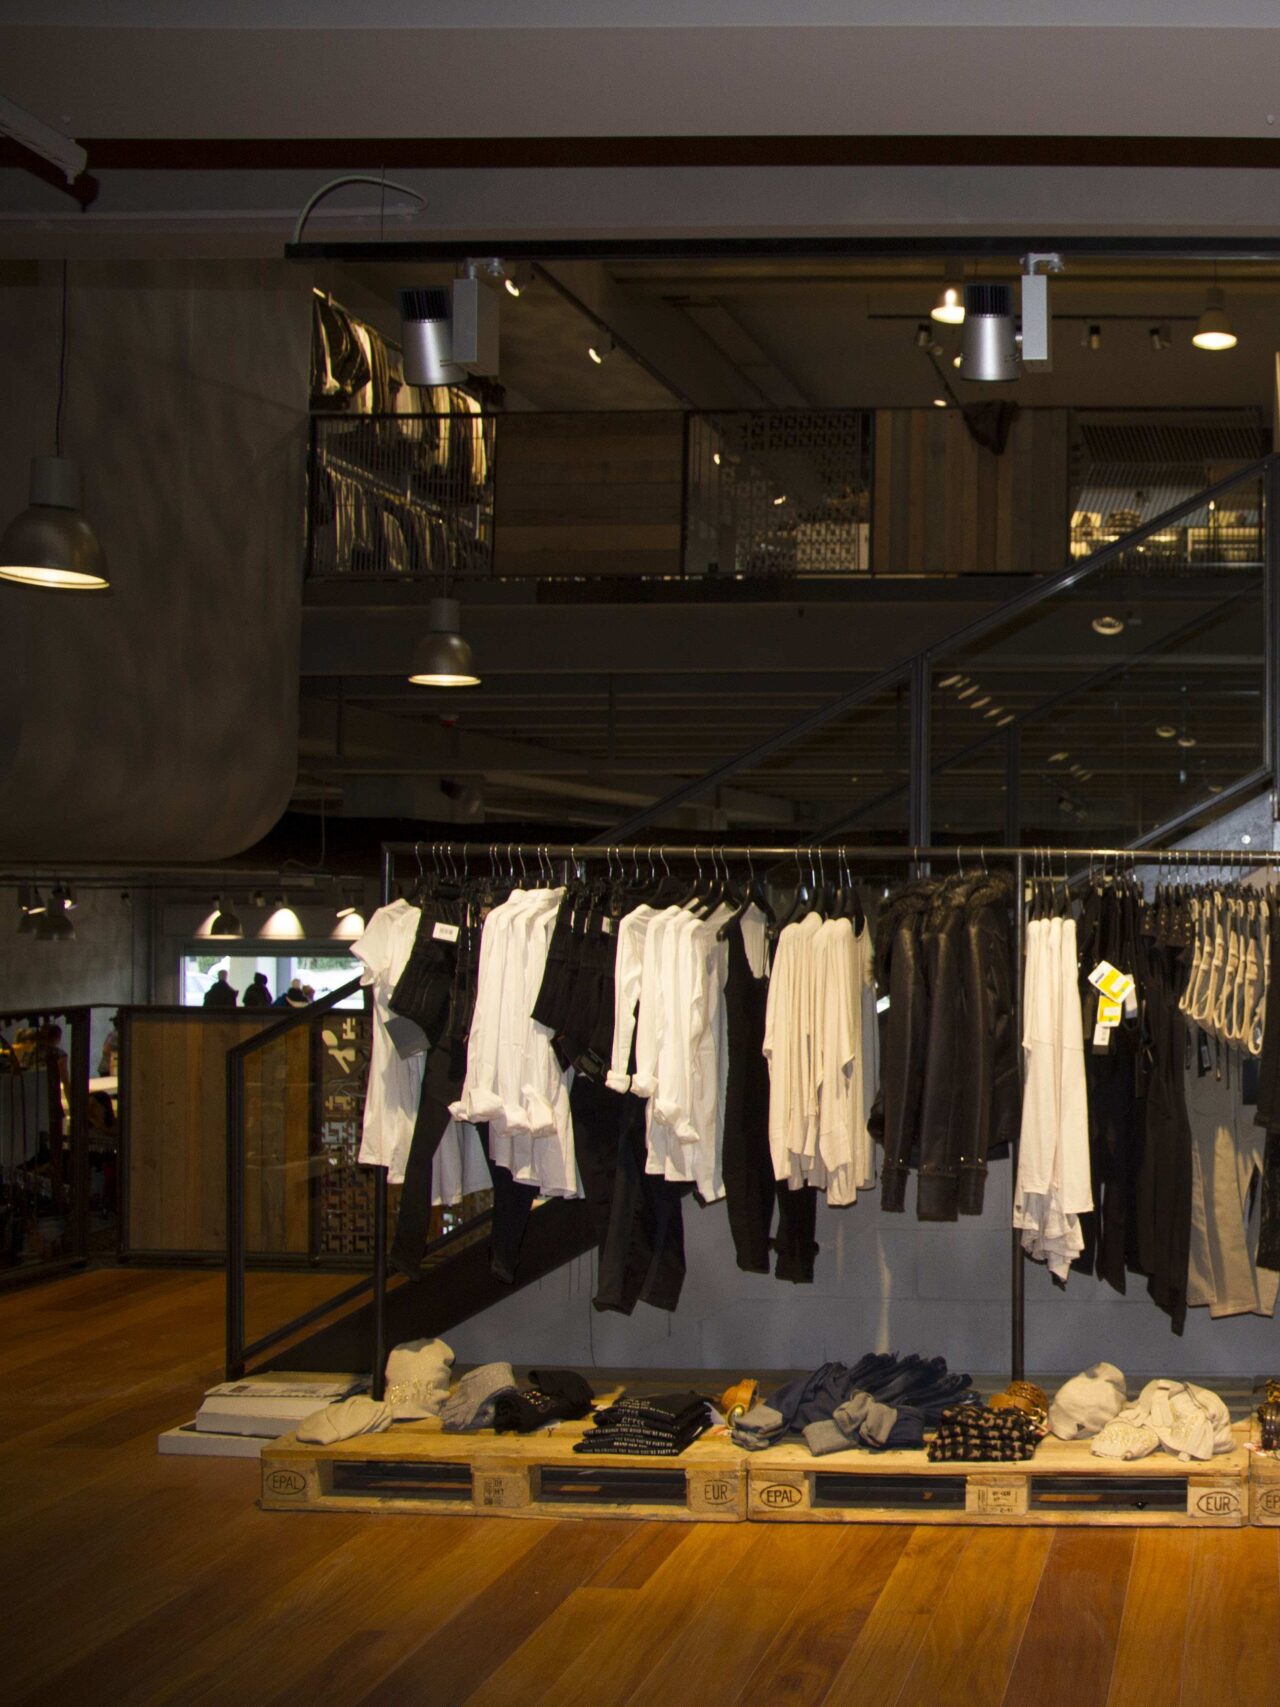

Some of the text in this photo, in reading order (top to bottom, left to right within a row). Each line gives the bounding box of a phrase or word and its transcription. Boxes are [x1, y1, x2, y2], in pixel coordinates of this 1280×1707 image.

[271, 1475, 300, 1490] EPAL
[704, 1484, 728, 1500] EUR
[766, 1489, 797, 1504] EPAL
[1205, 1496, 1231, 1511] EUR
